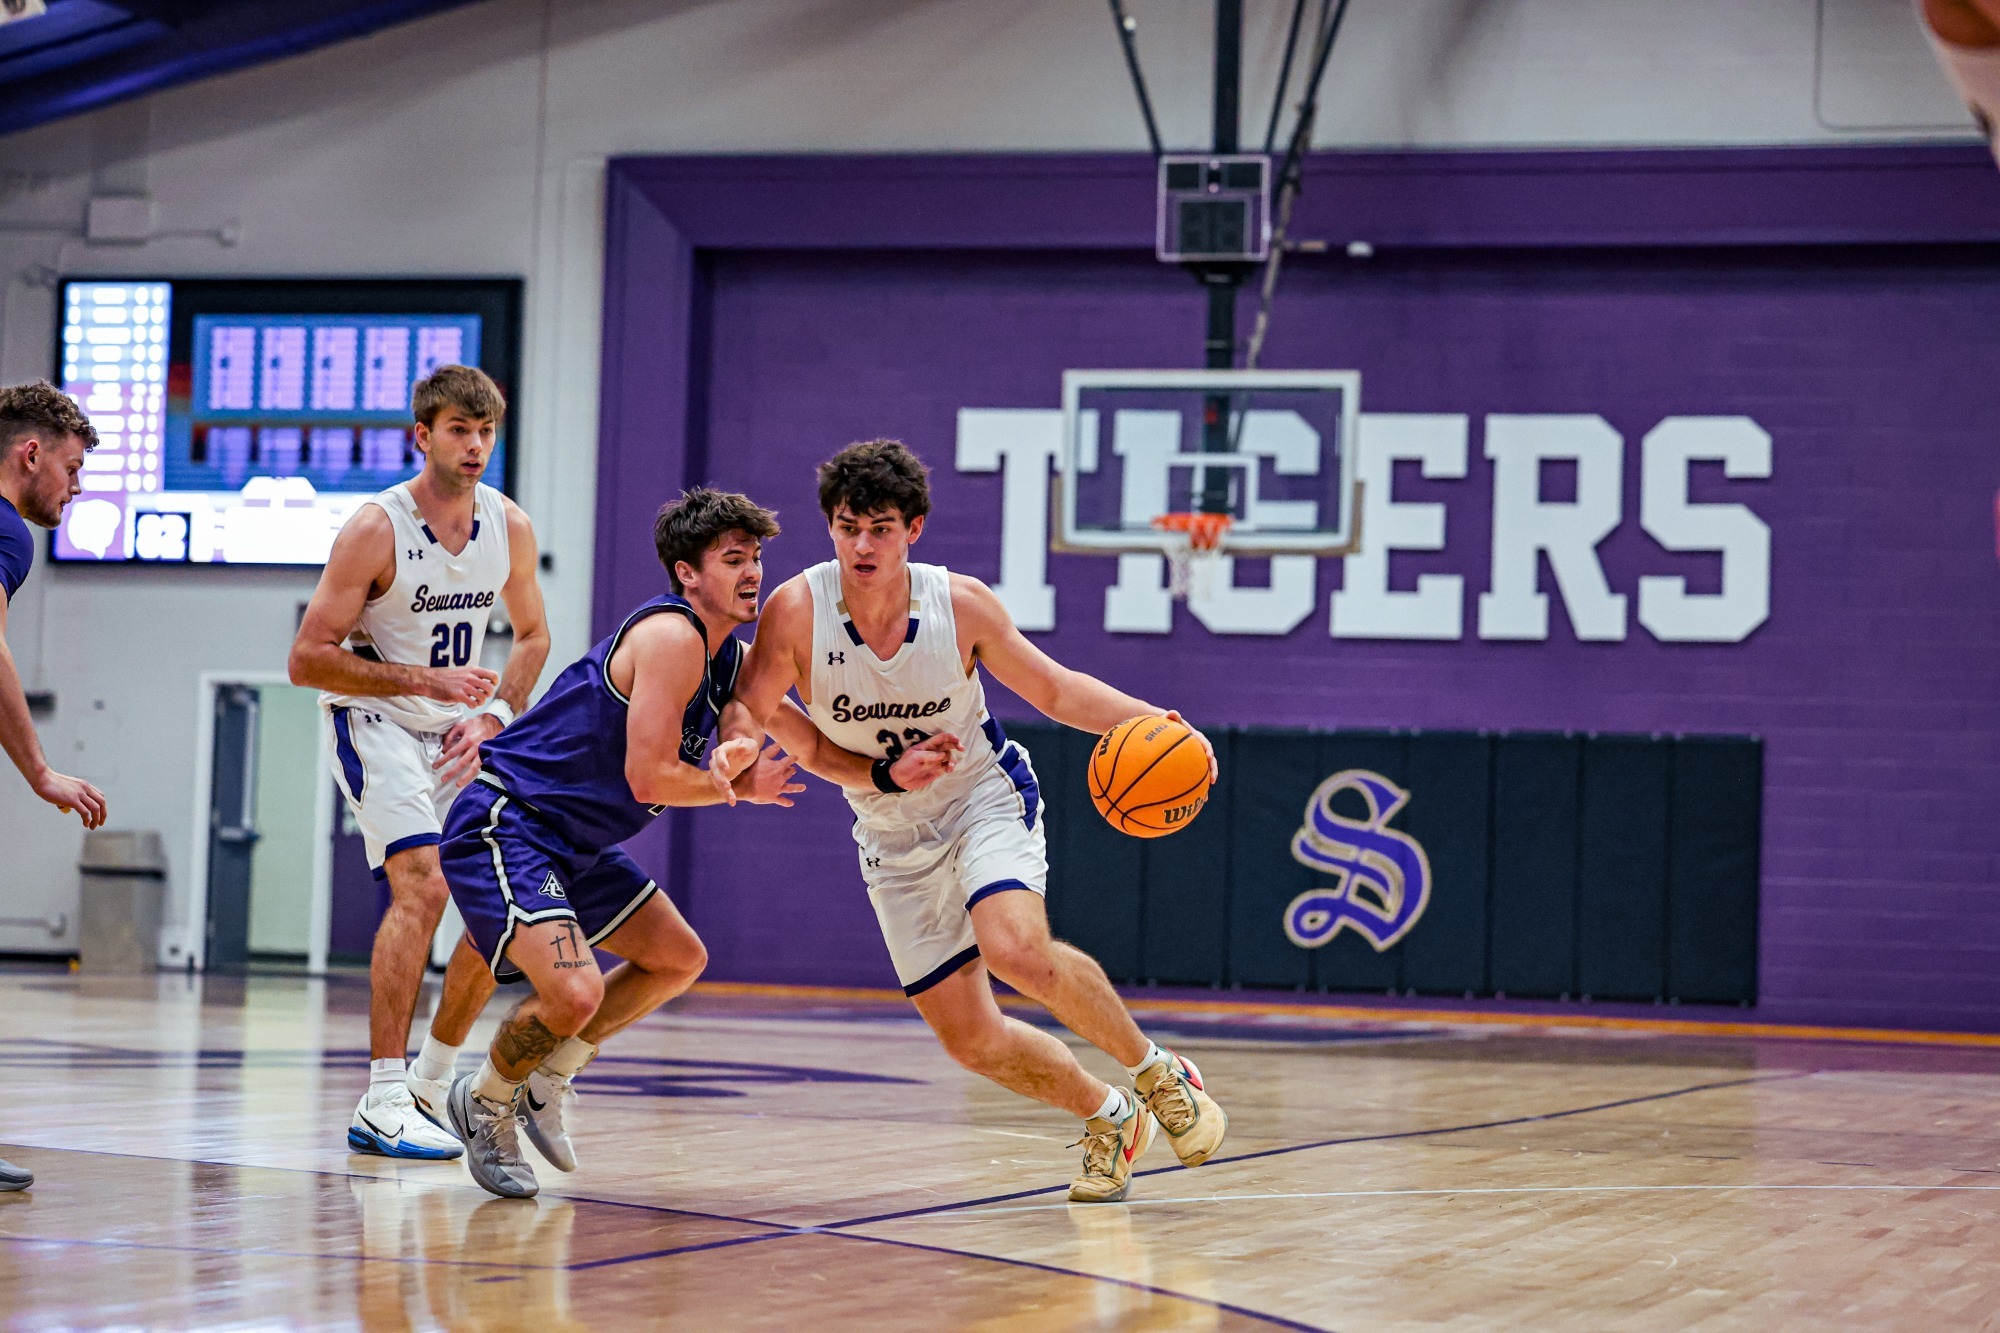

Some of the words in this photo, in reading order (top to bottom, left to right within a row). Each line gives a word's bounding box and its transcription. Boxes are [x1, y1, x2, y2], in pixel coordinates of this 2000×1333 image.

[955, 408, 1773, 642] TIGERS
[411, 584, 495, 614] Sewanee
[430, 622, 473, 667] 20
[832, 694, 952, 722] Sewanee
[1283, 769, 1432, 952] S
